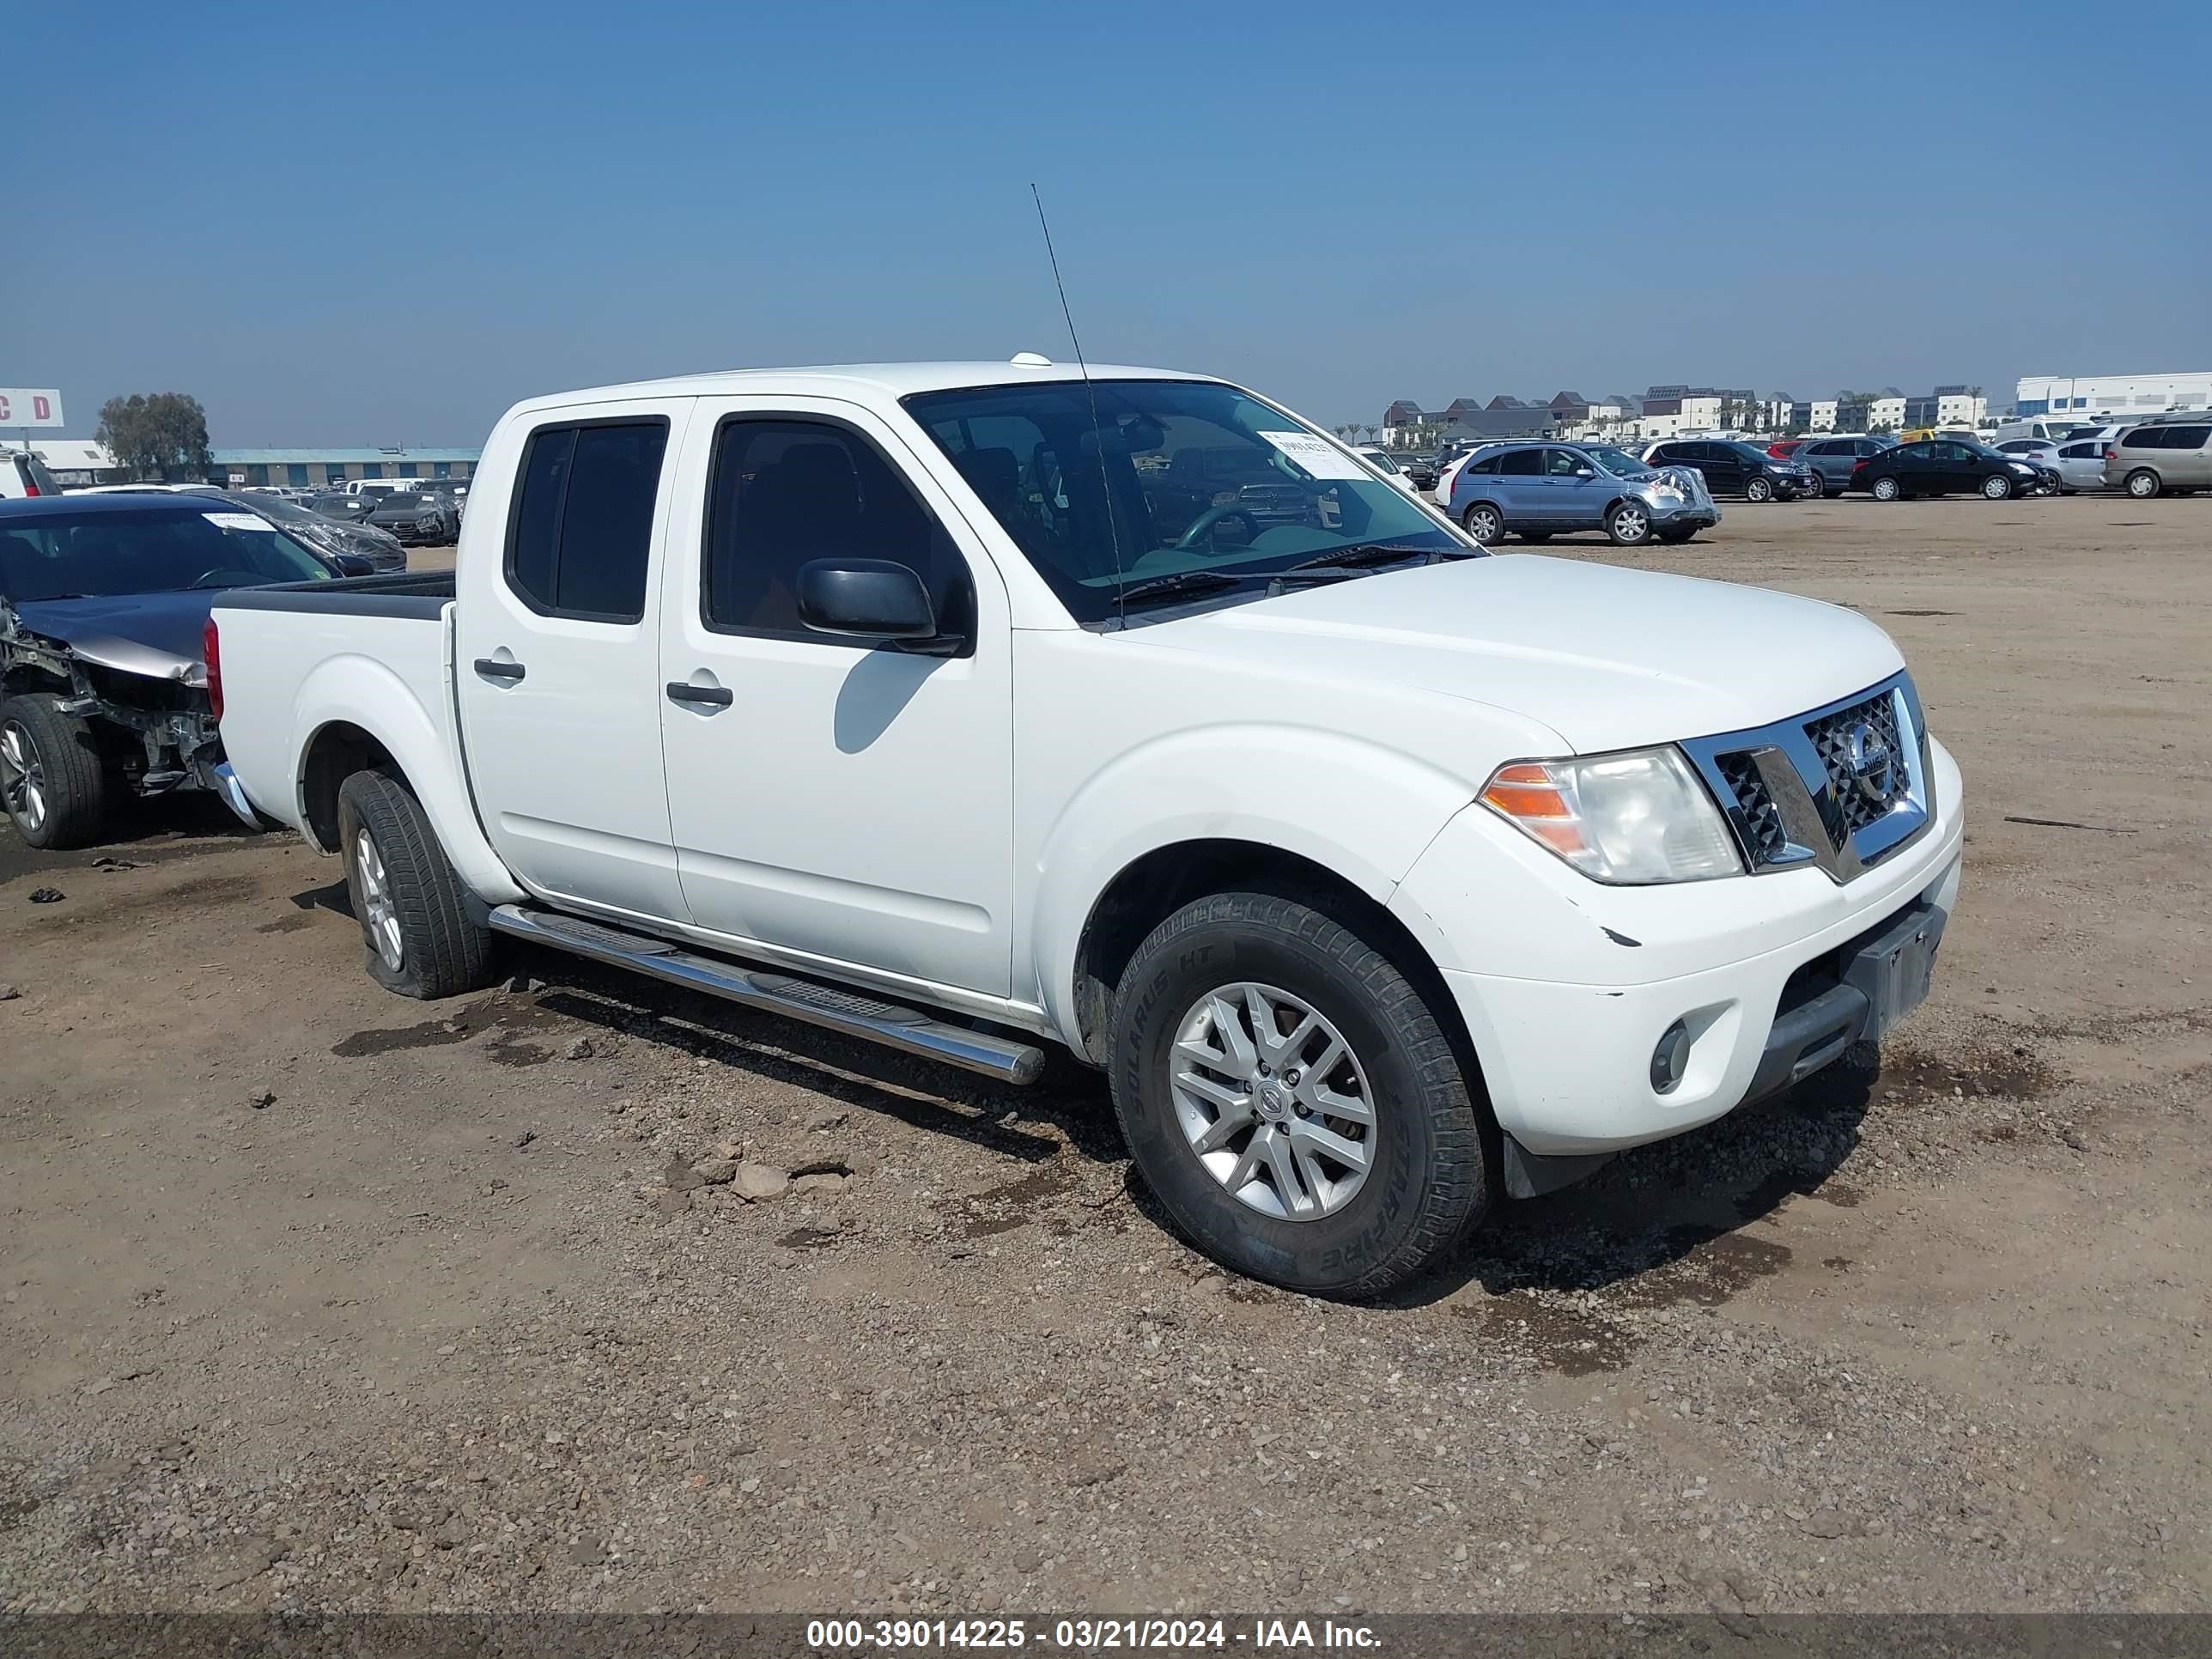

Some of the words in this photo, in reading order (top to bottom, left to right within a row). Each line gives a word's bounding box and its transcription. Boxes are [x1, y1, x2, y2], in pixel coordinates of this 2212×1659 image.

[33, 396, 50, 420] D
[1127, 969, 1169, 1120] SOLARUS
[1179, 945, 1215, 972] HT
[1321, 1120, 1410, 1273] STARFIRE
